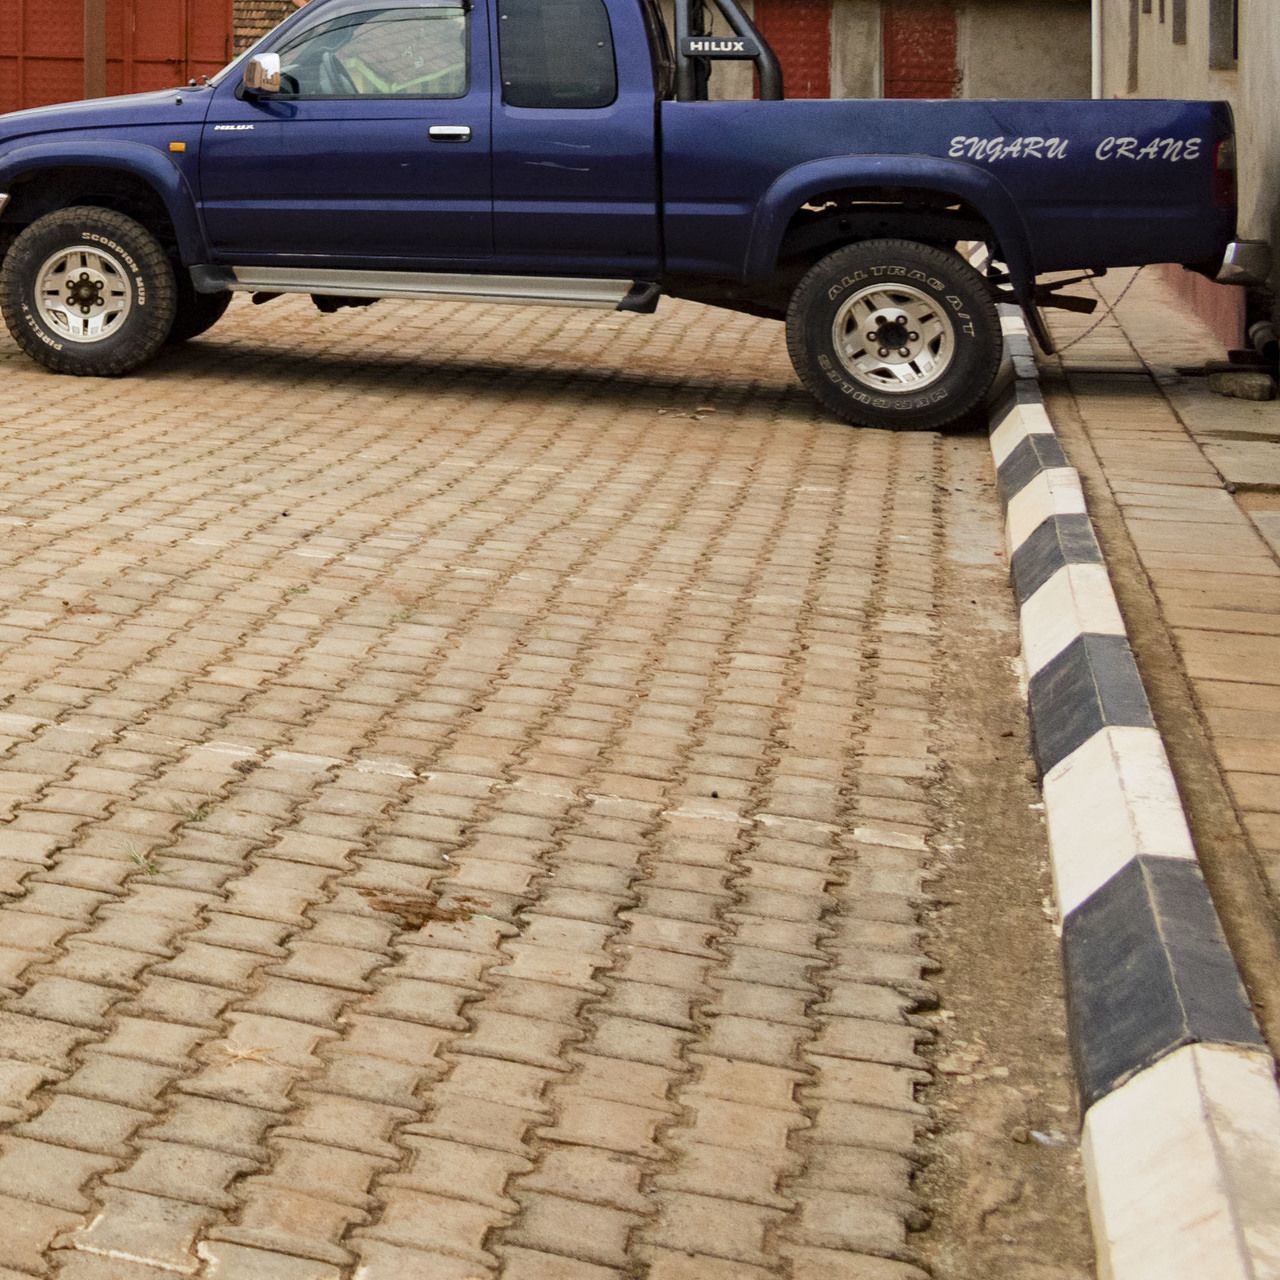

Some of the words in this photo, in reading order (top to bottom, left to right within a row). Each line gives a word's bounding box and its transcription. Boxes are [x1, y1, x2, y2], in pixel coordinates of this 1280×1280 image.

[689, 41, 745, 51] HILUX
[948, 135, 1070, 162] ENGARU
[1095, 136, 1203, 162] CRANE
[81, 232, 139, 273] SCORPION
[135, 276, 146, 306] MUD
[25, 314, 64, 351] PIRELLI
